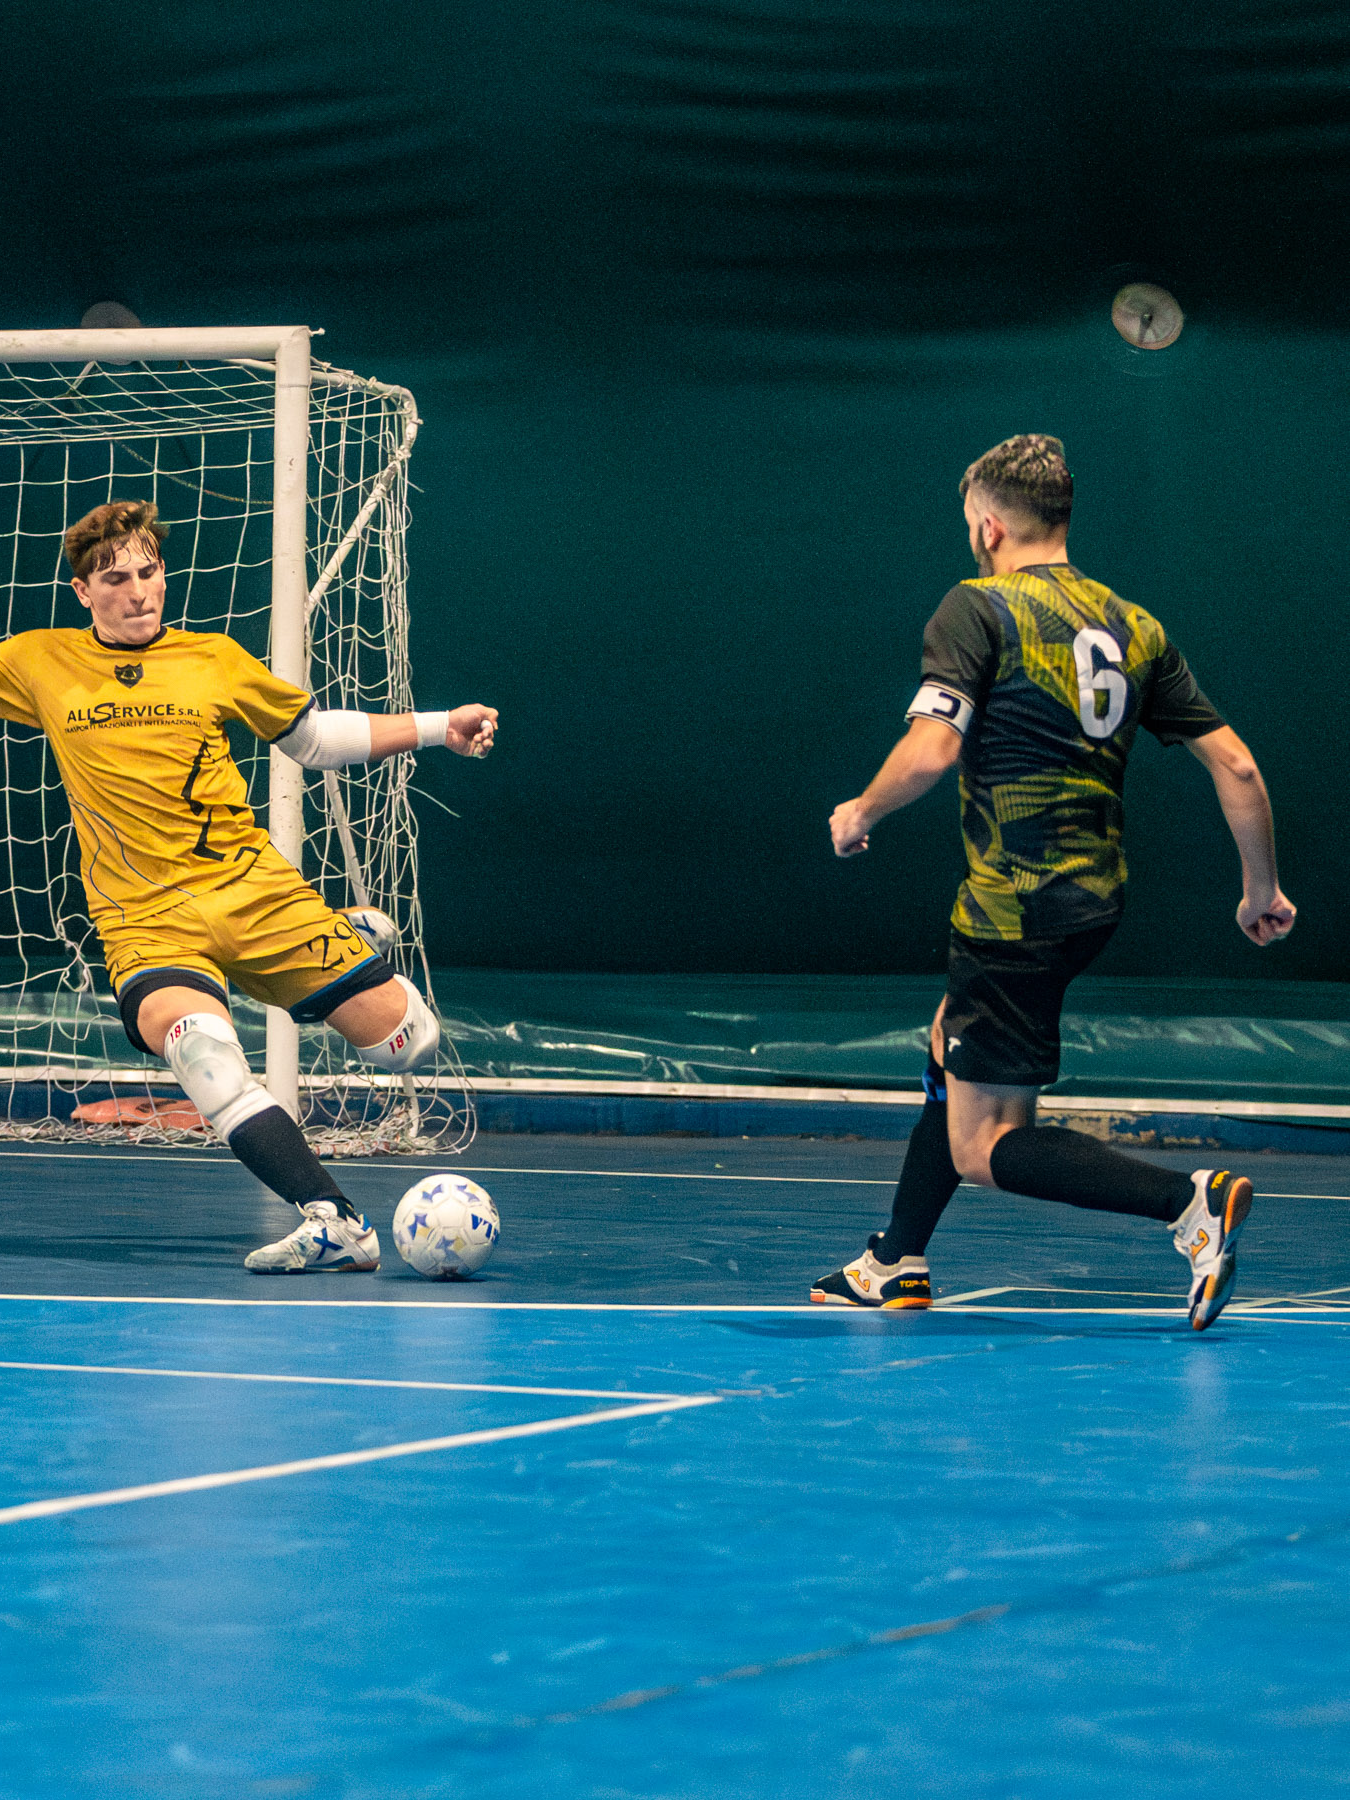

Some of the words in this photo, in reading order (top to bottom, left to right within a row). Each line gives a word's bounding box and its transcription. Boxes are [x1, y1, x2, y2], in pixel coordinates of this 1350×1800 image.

[1073, 627, 1128, 739] 6
[306, 921, 363, 972] 29
[170, 1019, 187, 1045] 181
[388, 1026, 411, 1055] 181
